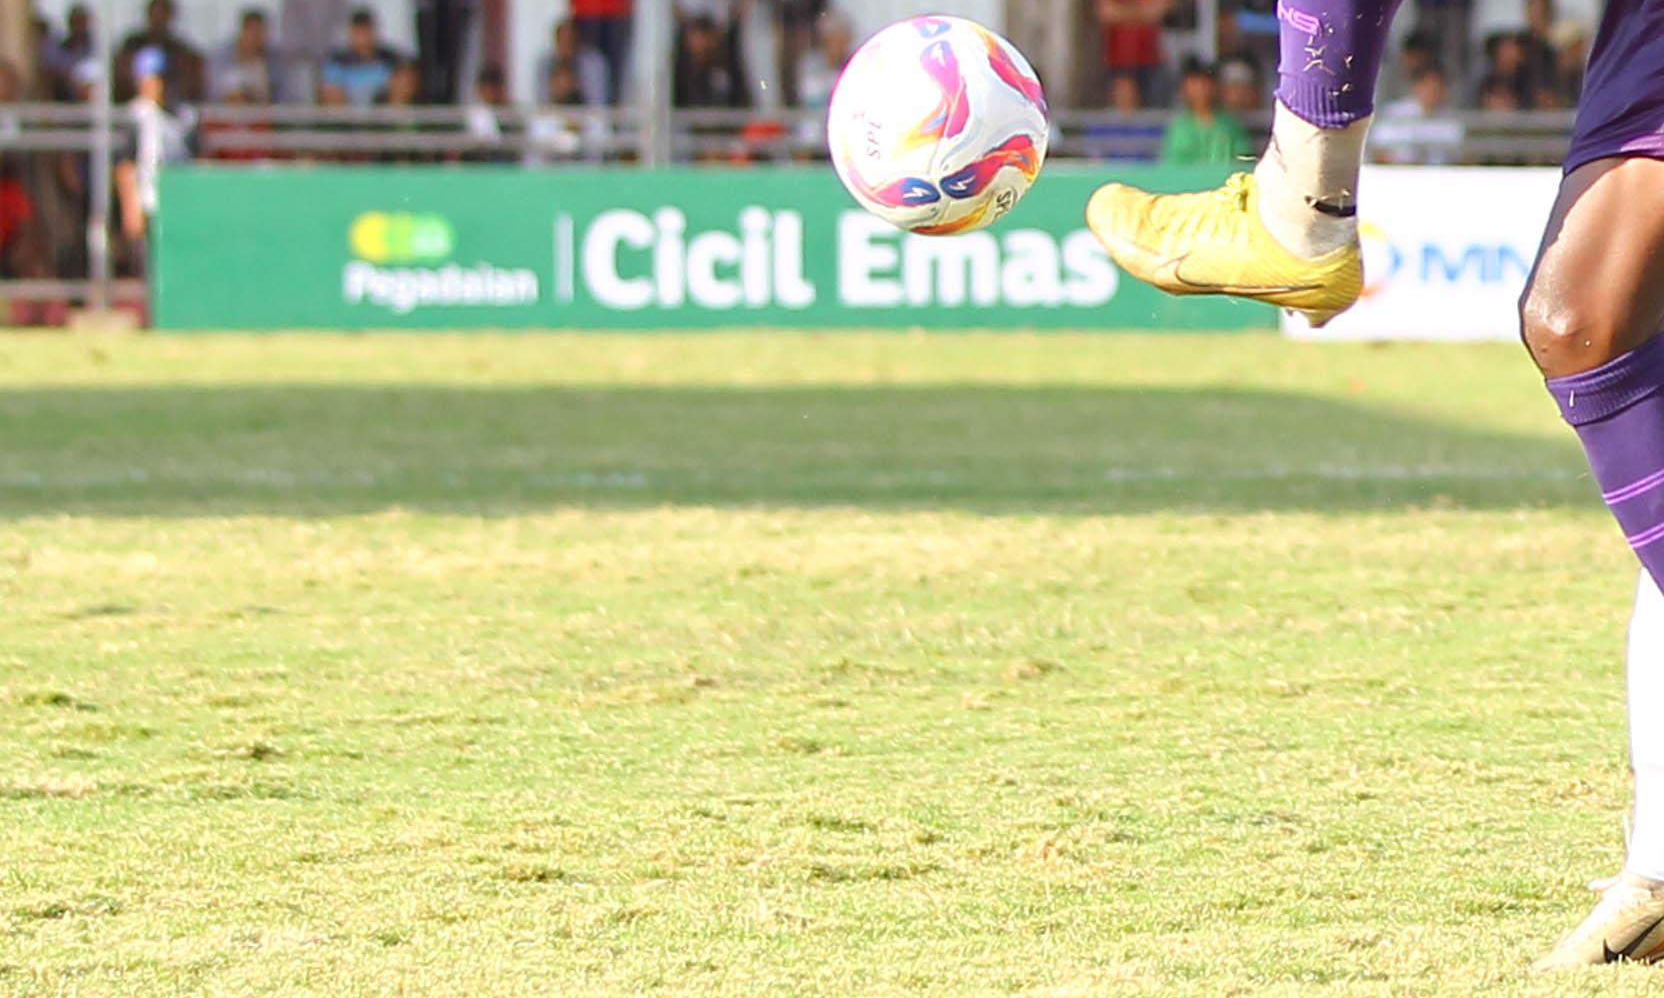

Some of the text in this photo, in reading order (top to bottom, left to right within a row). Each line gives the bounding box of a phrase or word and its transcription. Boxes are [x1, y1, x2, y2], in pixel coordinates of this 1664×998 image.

[342, 260, 539, 314] Pegadaian
[581, 205, 1119, 309] Cicil Emas
